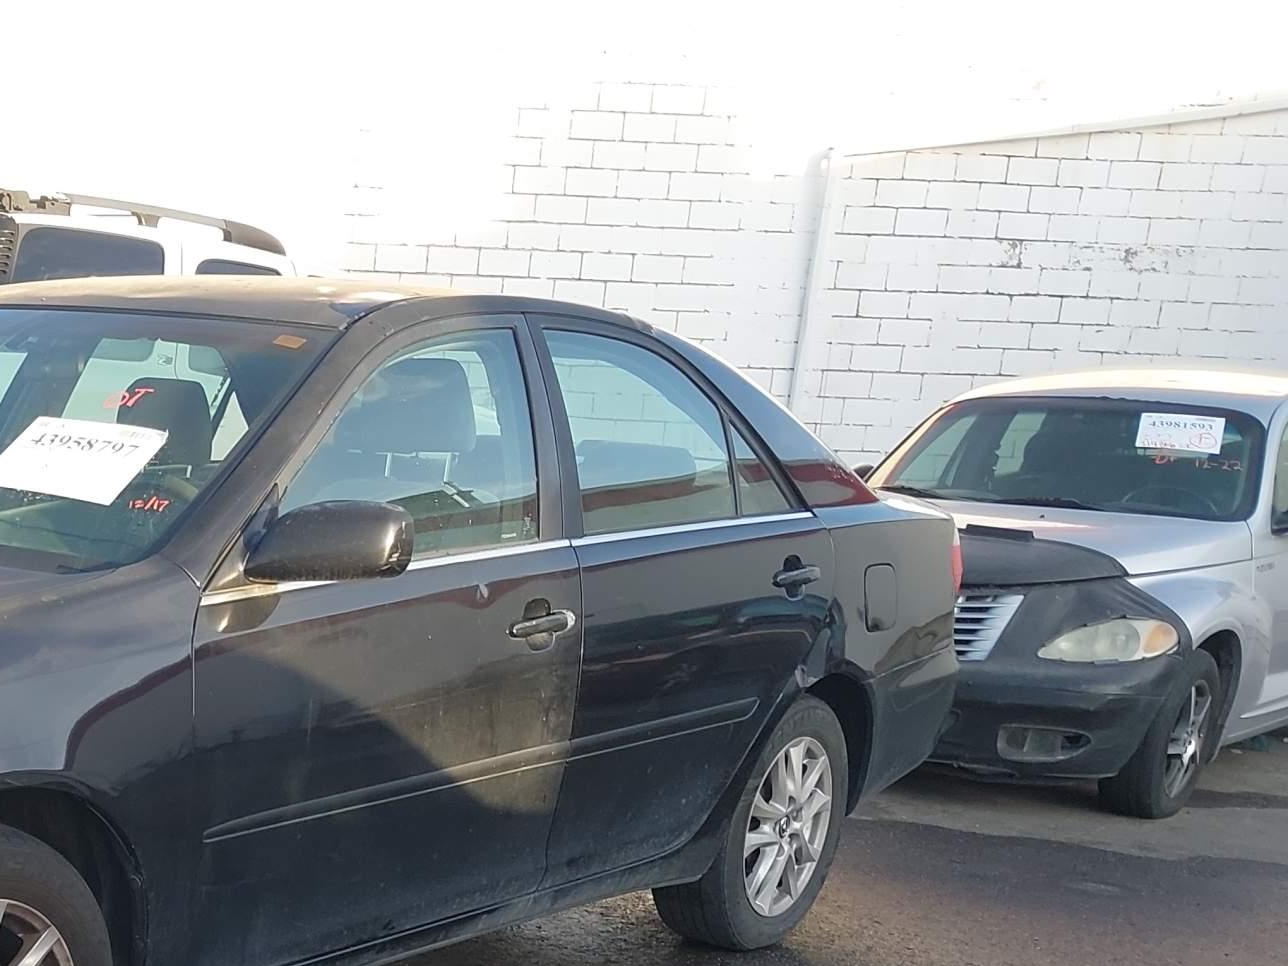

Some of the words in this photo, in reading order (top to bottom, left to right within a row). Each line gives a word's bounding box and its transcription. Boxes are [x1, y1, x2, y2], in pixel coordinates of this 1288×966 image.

[1148, 420, 1215, 432] 43981593
[31, 432, 141, 457] 43958797
[128, 495, 170, 512] 12/17
